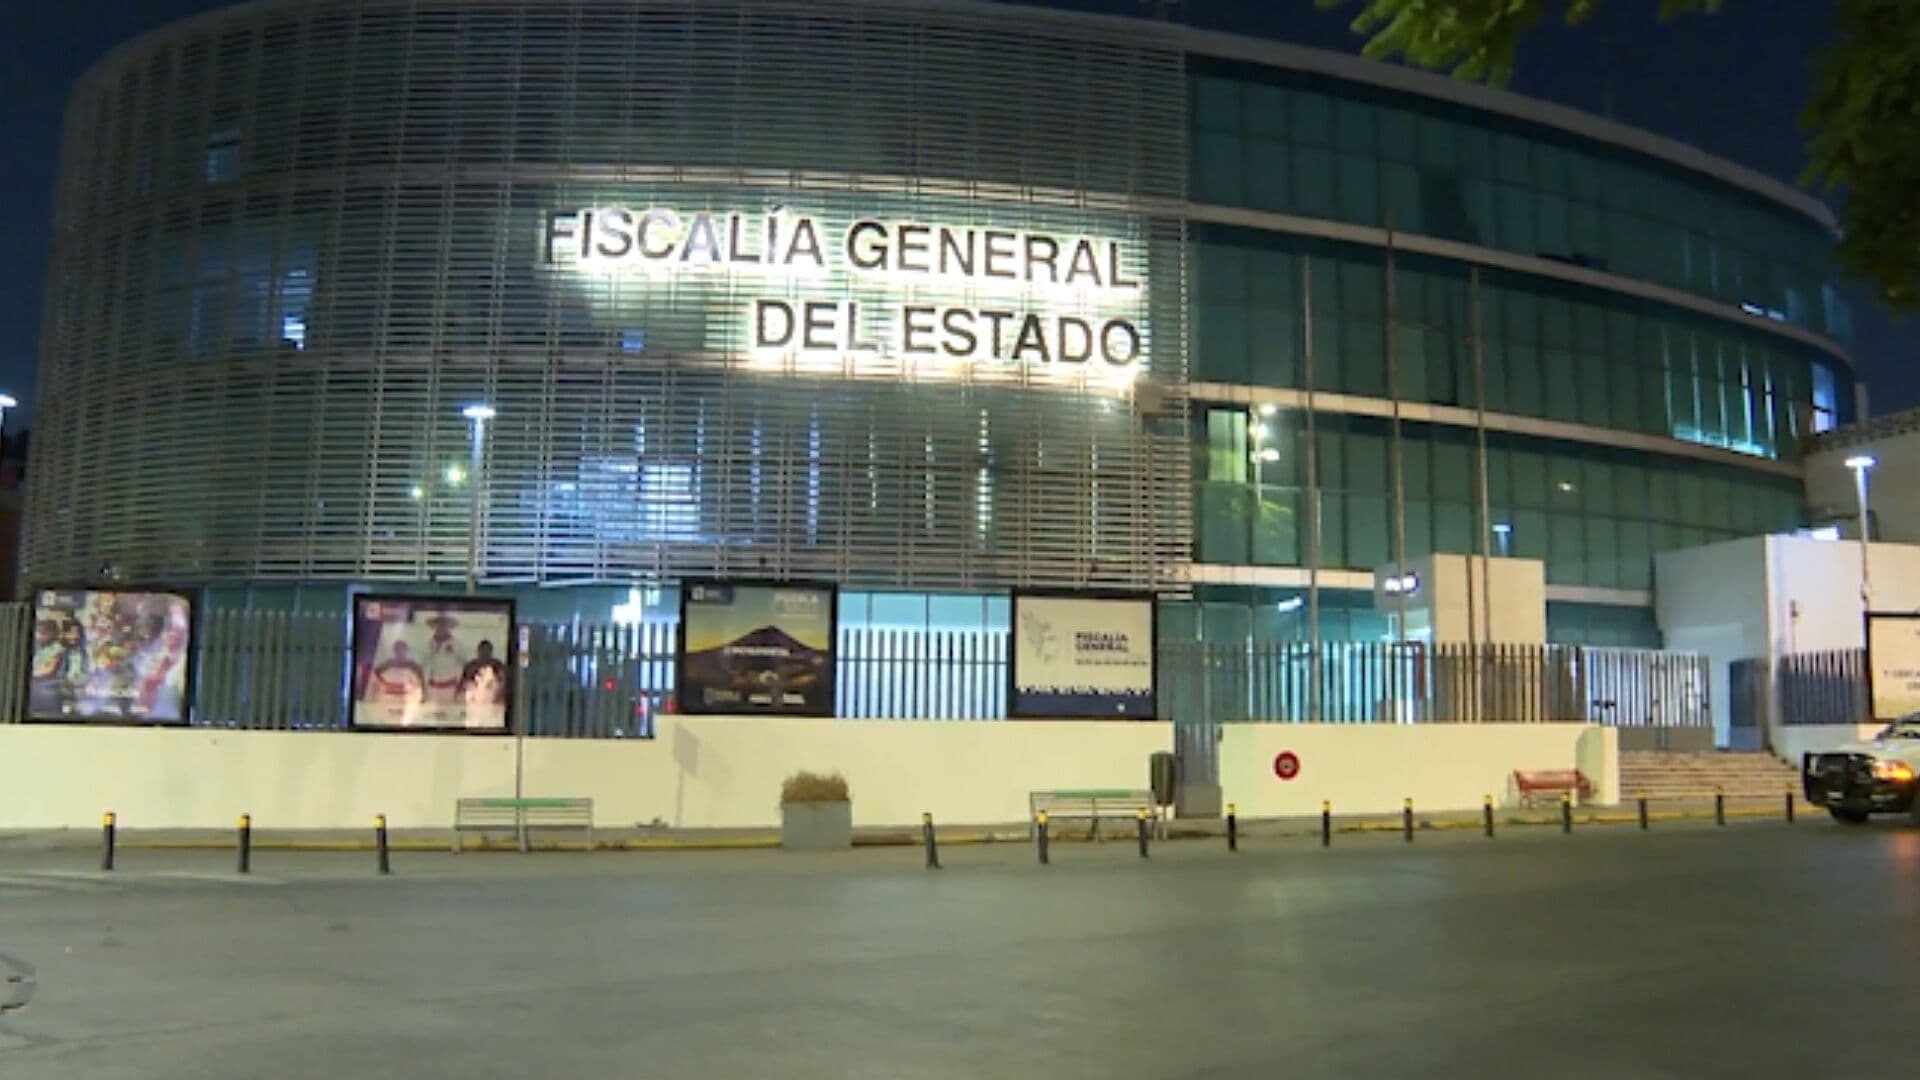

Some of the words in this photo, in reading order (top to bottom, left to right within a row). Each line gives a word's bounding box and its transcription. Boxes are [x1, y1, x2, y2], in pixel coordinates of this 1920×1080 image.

[543, 205, 824, 267] FISCALÍA
[848, 214, 1140, 288] GENERAL
[756, 300, 878, 352] DEL
[903, 306, 1141, 367] ESTADO
